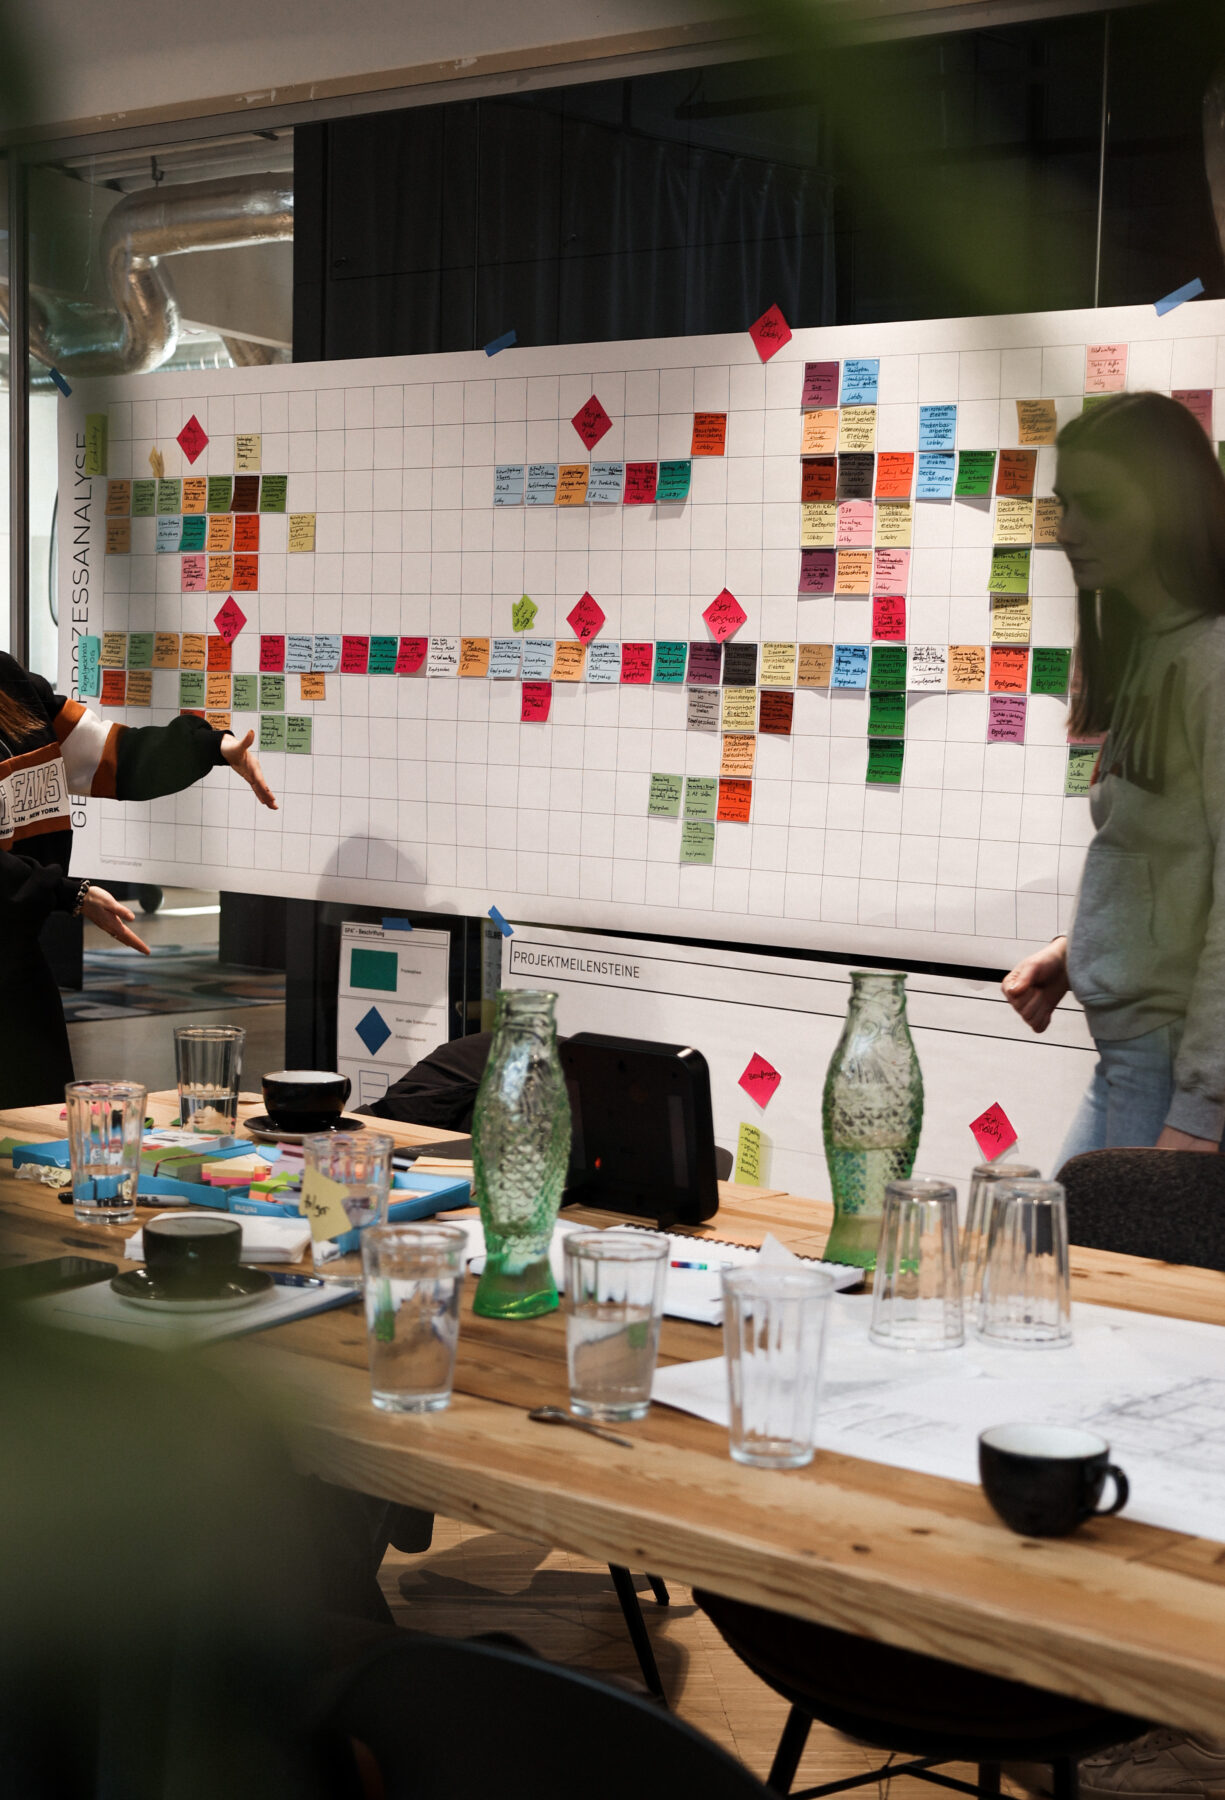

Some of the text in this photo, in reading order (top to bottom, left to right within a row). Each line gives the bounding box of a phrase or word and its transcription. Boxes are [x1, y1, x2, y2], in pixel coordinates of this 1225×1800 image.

[847, 392, 863, 402] Lobby
[847, 442, 869, 450] Lobby
[989, 581, 1007, 591] Lobby
[41, 806, 60, 814] YORK
[513, 951, 640, 979] PROJEKTMEILENSTEINE
